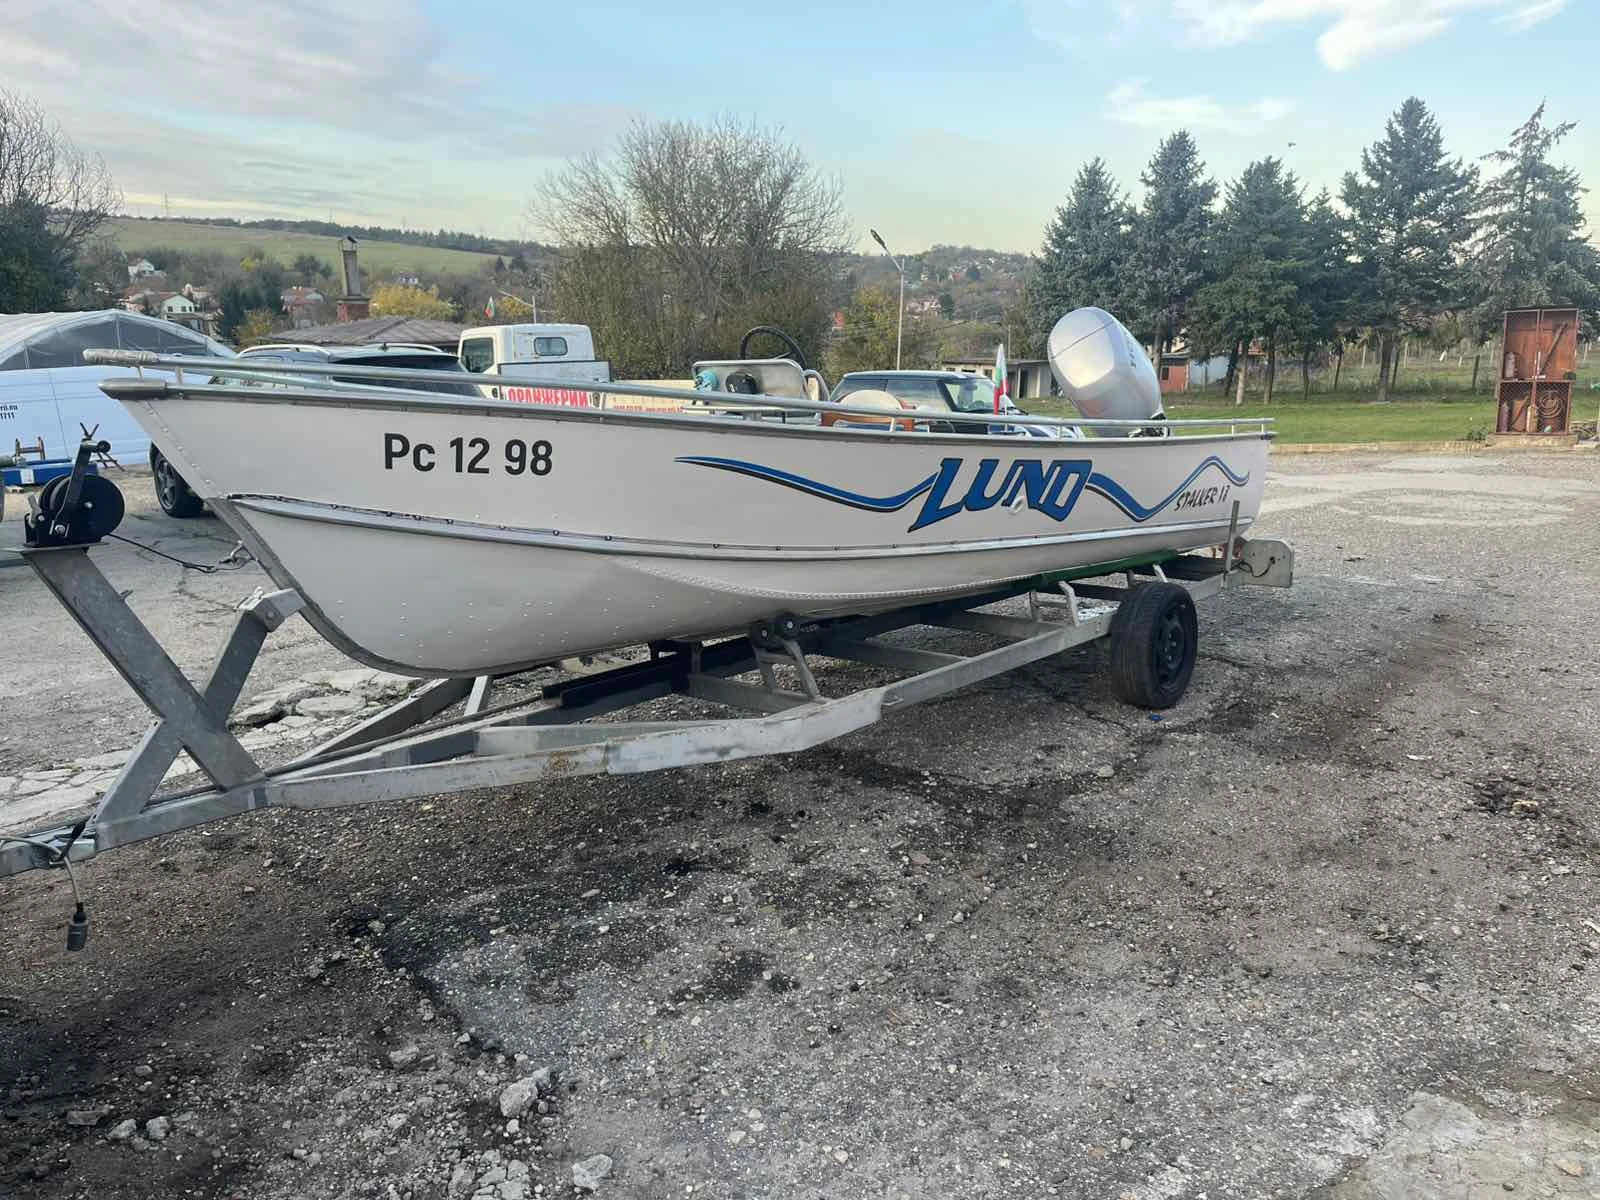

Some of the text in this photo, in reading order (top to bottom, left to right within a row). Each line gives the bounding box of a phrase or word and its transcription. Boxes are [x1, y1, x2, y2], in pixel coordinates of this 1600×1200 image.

[450, 437, 490, 474] 12
[504, 439, 553, 476] 98
[907, 458, 1092, 533] LUND
